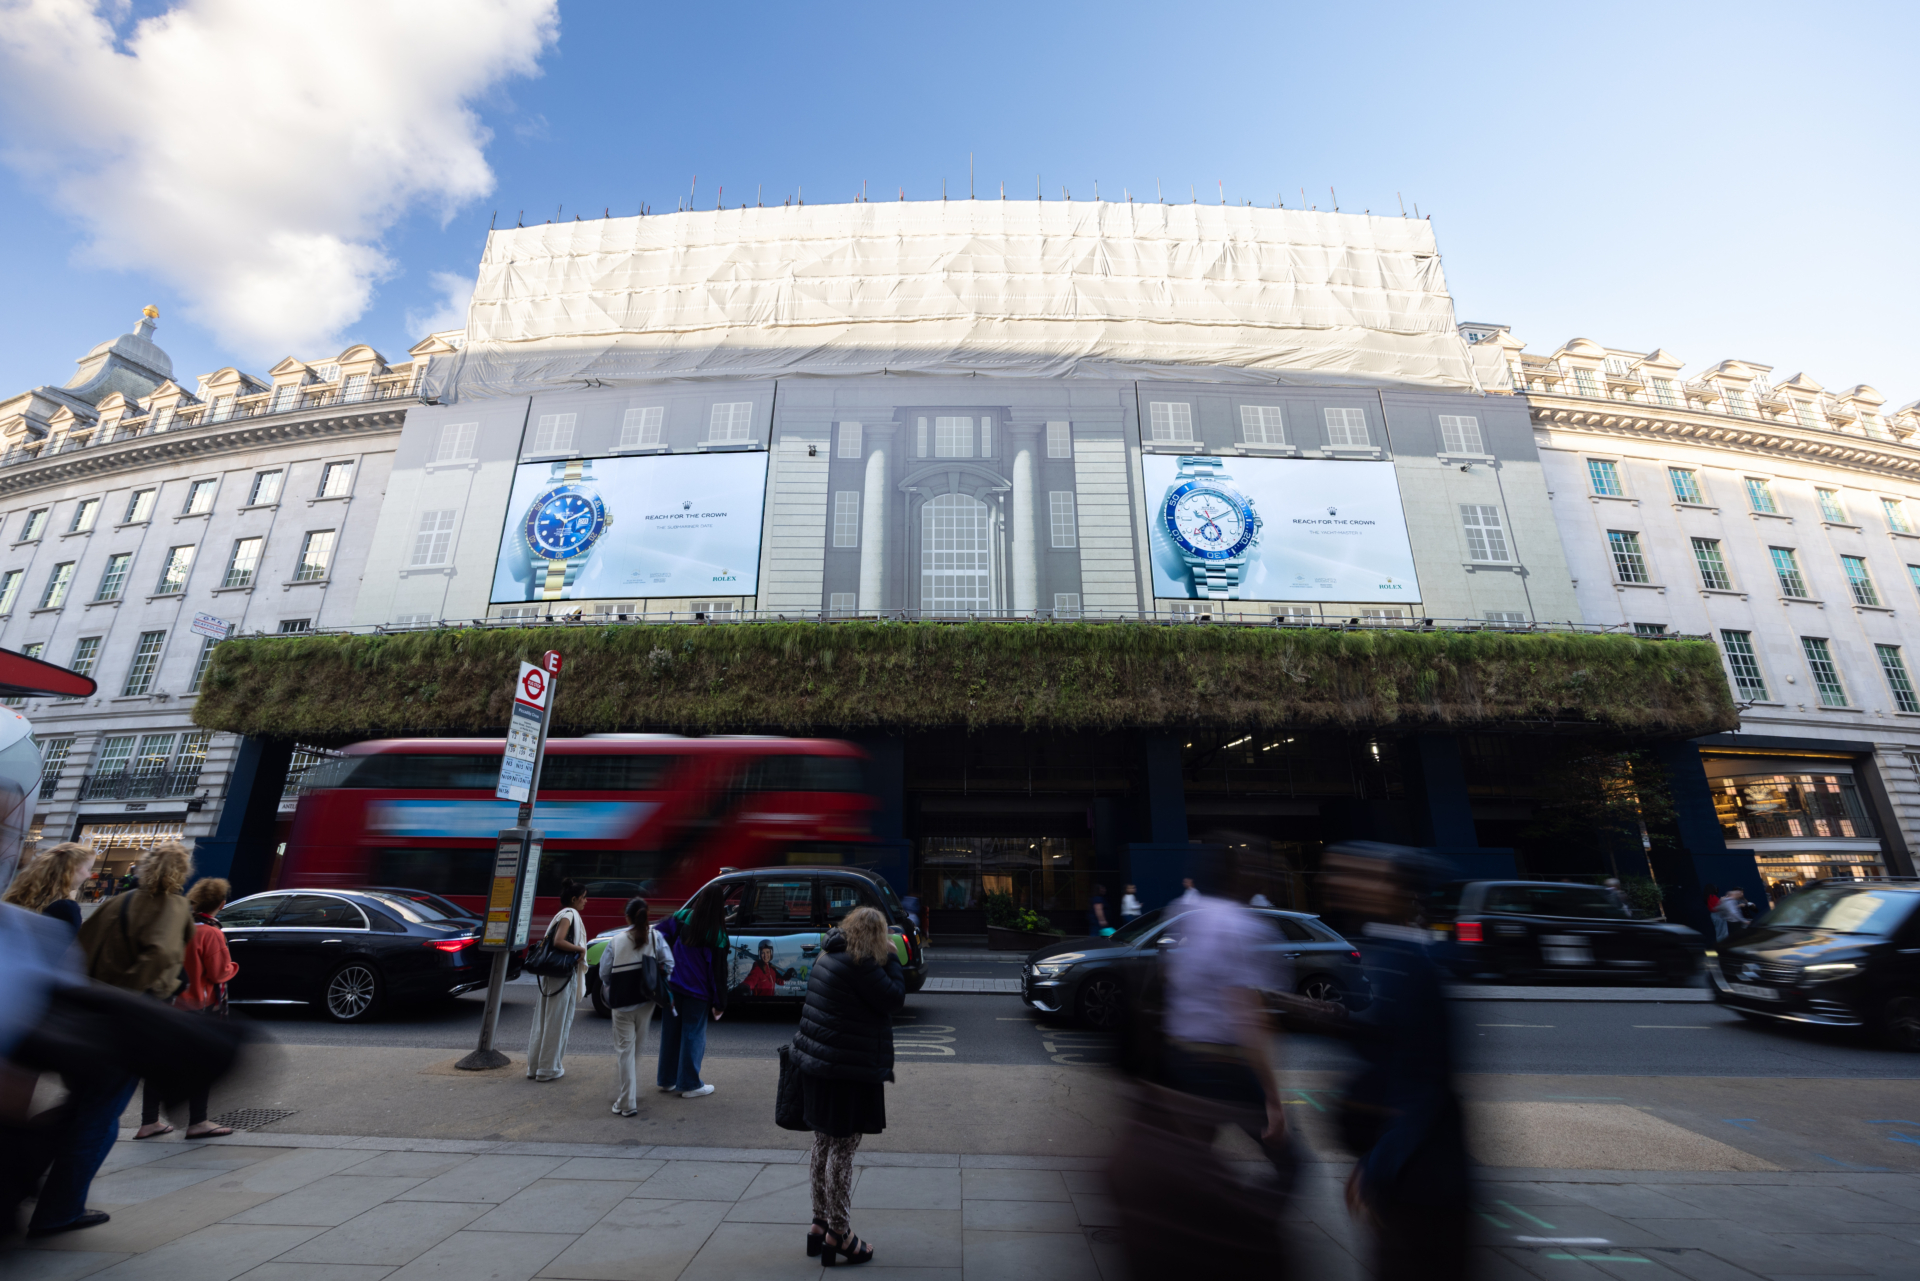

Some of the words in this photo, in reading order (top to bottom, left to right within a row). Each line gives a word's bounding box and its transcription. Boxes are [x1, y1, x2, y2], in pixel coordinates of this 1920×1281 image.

[1169, 494, 1179, 506] 50
[1237, 498, 1246, 508] 10
[535, 503, 544, 511] 50
[588, 532, 597, 541] 20
[1172, 530, 1183, 542] 40
[1241, 532, 1251, 544] 20
[549, 653, 559, 672] E
